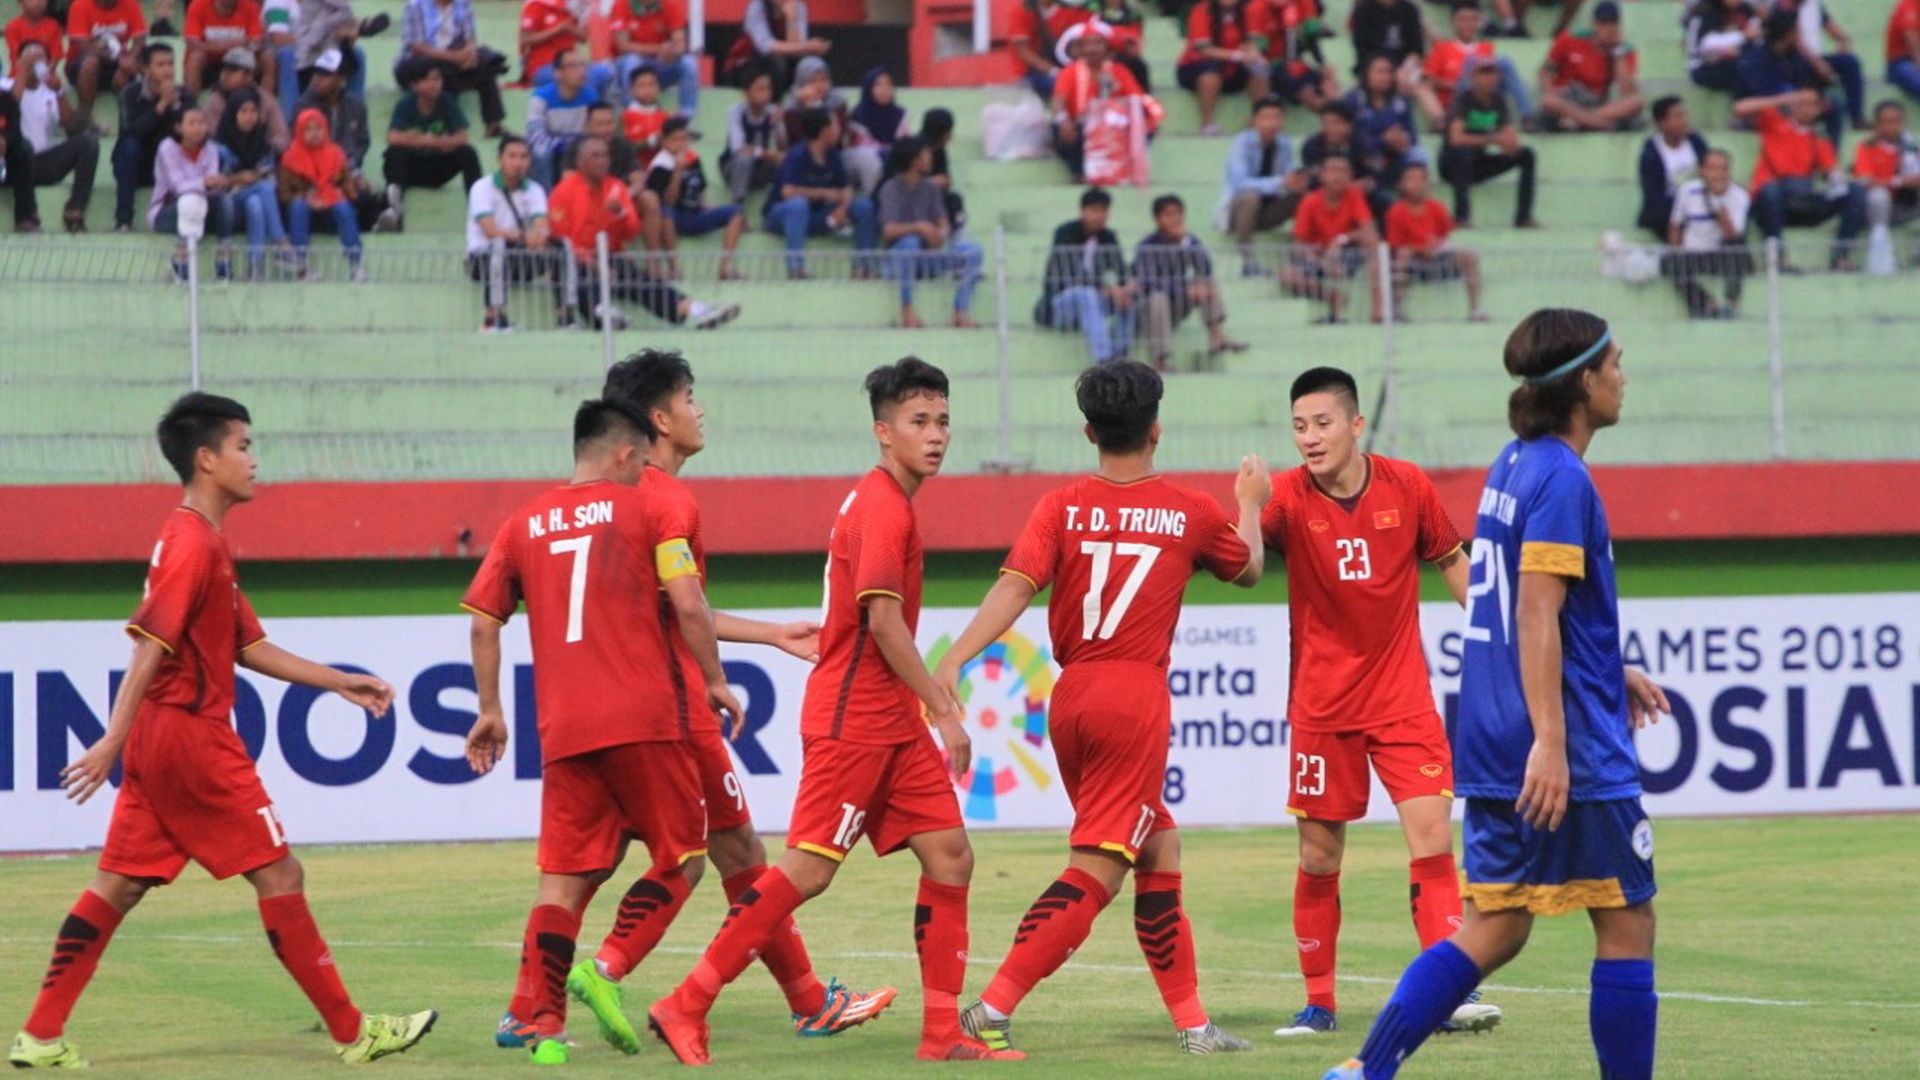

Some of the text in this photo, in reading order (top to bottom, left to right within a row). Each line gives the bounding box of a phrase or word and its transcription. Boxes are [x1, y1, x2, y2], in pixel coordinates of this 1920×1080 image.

[528, 501, 613, 539] N. H. SON
[1066, 505, 1186, 538] T. D. TRUNG
[1336, 538, 1372, 581] 23
[549, 535, 593, 643] 7
[1080, 541, 1162, 640] 17
[1464, 538, 1510, 645] 21
[1185, 626, 1256, 646] GAMES
[1622, 626, 1762, 673] AMES
[1782, 625, 1902, 672] 2018
[1168, 661, 1255, 696] arta
[1296, 752, 1326, 796] 23
[833, 802, 866, 849] 18
[1131, 804, 1156, 848] 17
